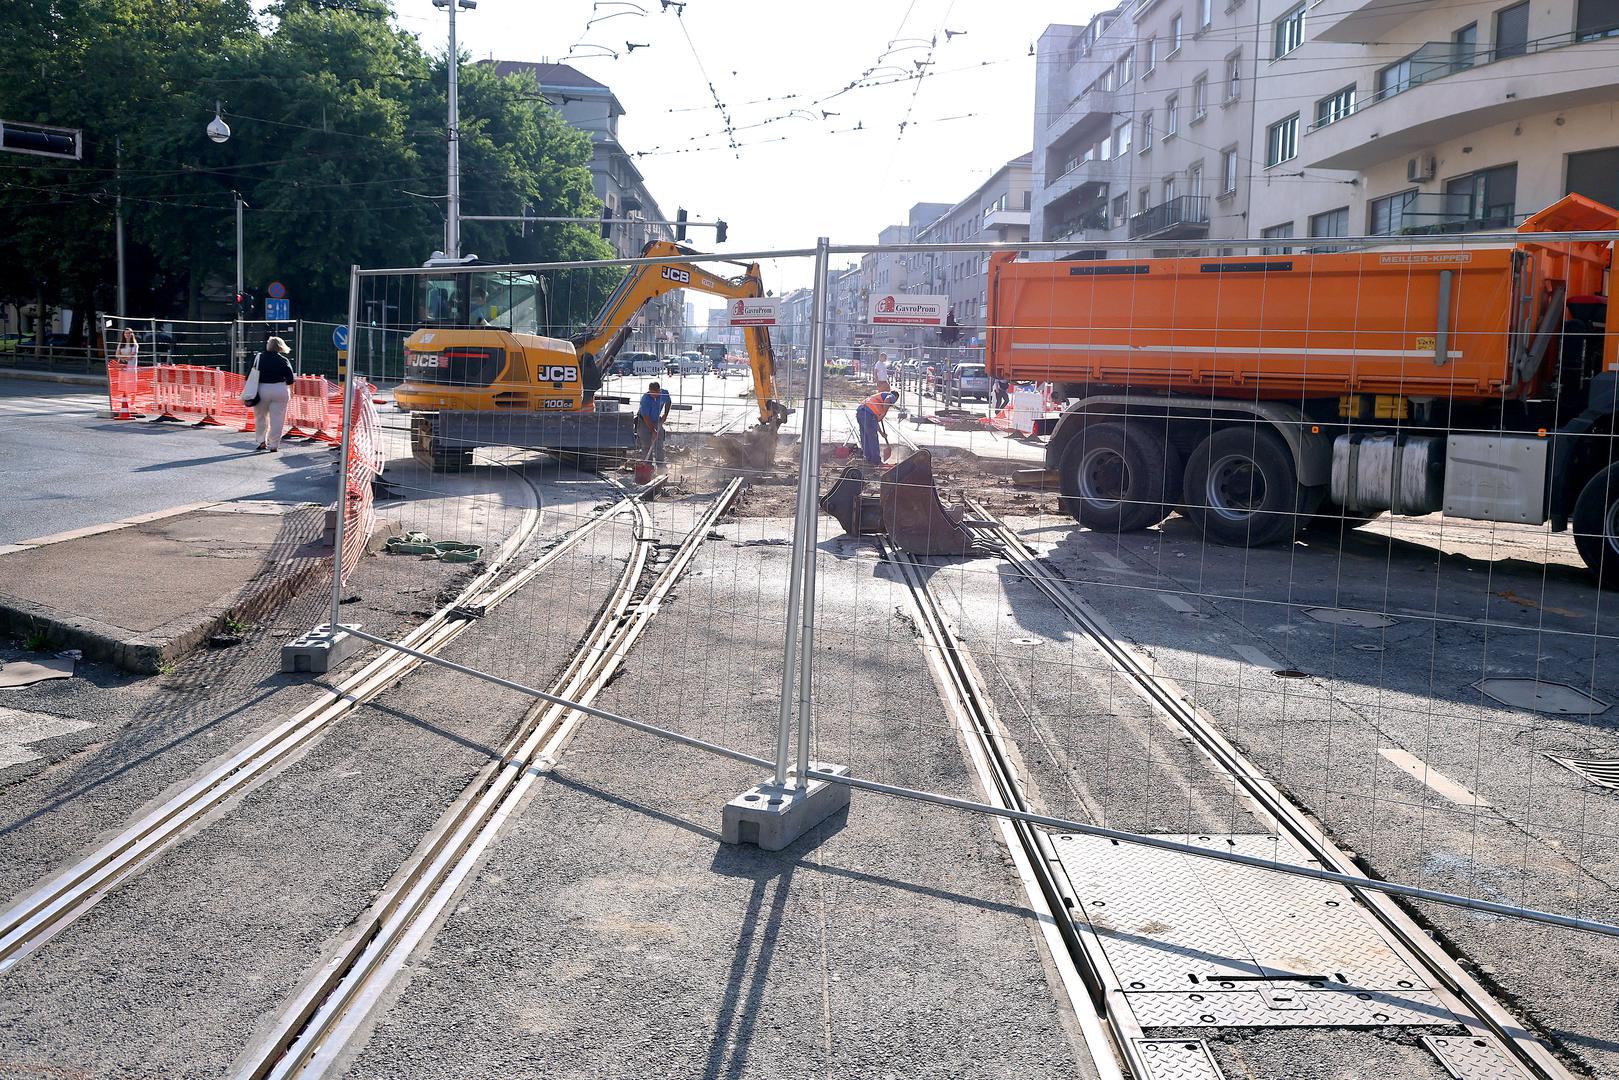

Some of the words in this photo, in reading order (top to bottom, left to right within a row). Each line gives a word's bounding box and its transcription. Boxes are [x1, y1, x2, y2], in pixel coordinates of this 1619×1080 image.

[1381, 254, 1469, 264] MEILLER-KIPPER
[662, 267, 690, 283] JCB
[895, 304, 936, 313] GavroProm
[412, 354, 439, 367] JCB
[538, 366, 577, 381] JCB
